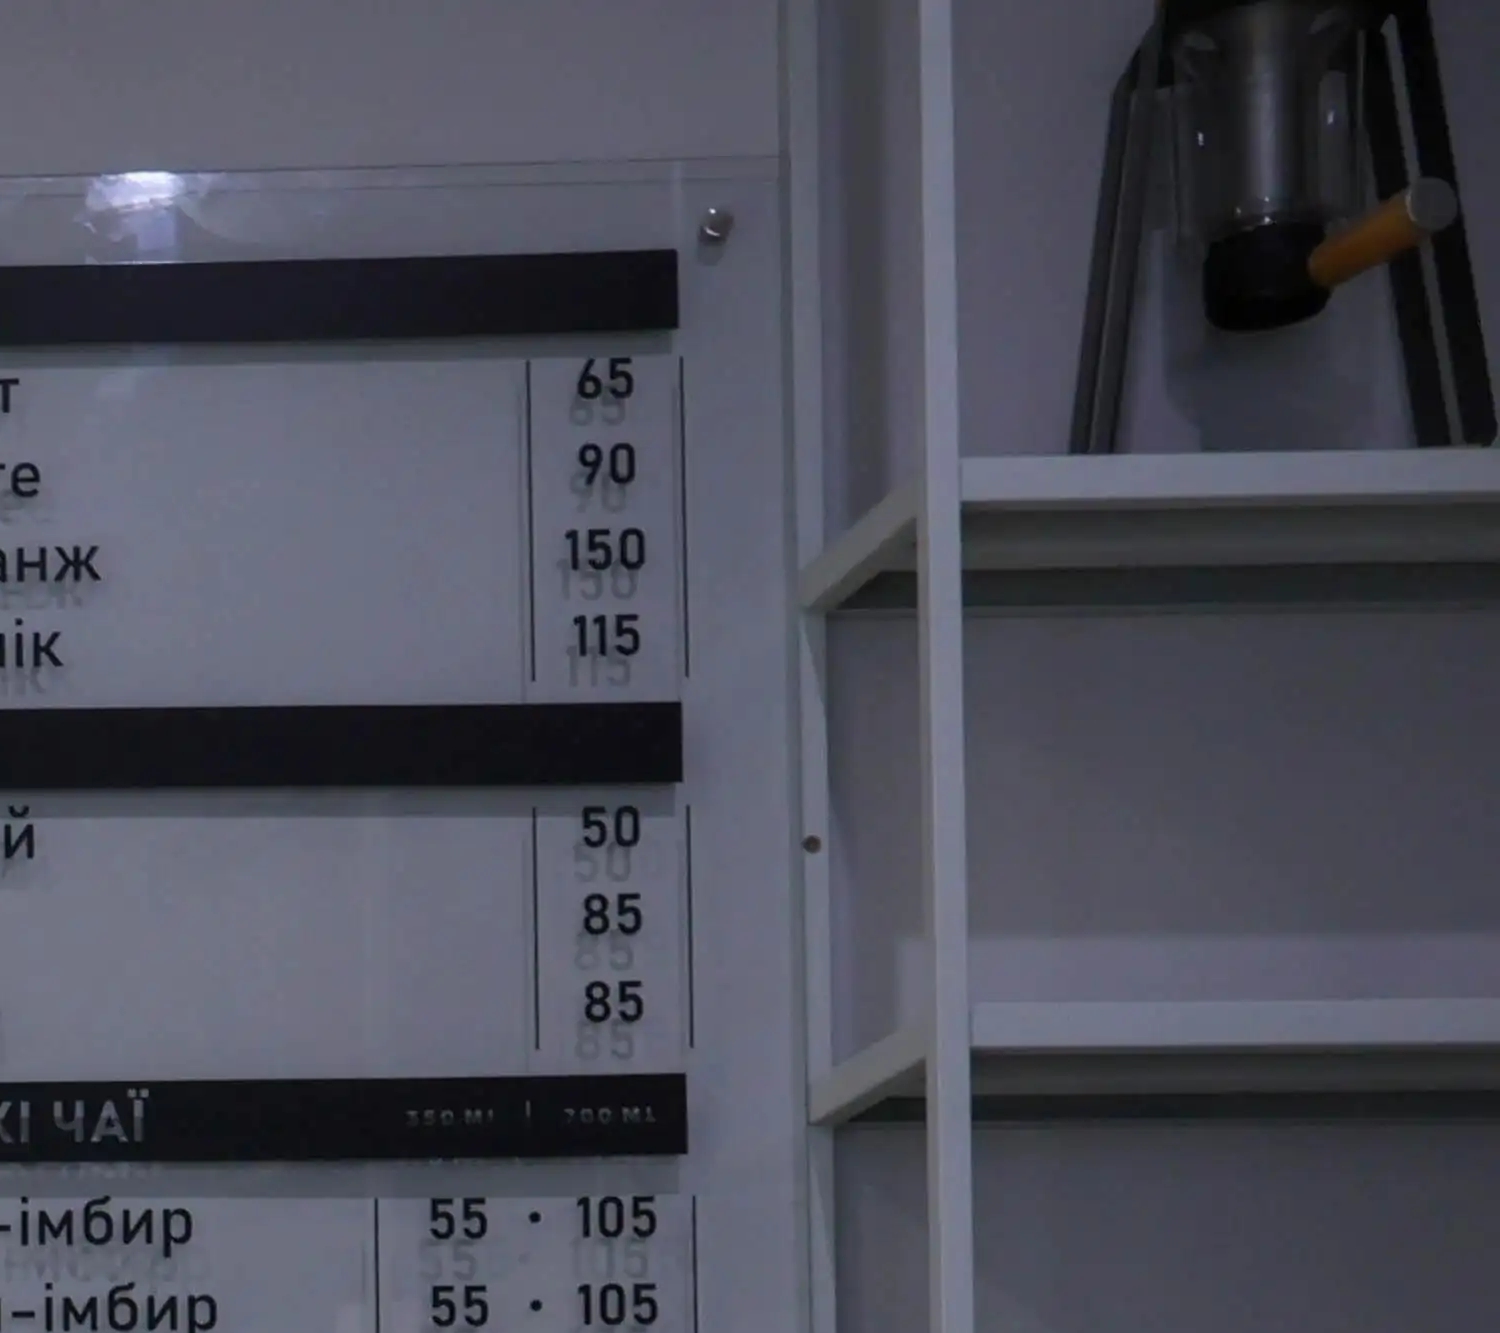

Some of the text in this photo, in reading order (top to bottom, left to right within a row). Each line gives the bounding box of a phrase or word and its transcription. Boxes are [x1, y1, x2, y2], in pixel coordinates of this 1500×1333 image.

[573, 614, 640, 657] 115
[583, 893, 642, 936] 85
[54, 1089, 147, 1144] ЧАЇ
[430, 1195, 656, 1240] 55 105
